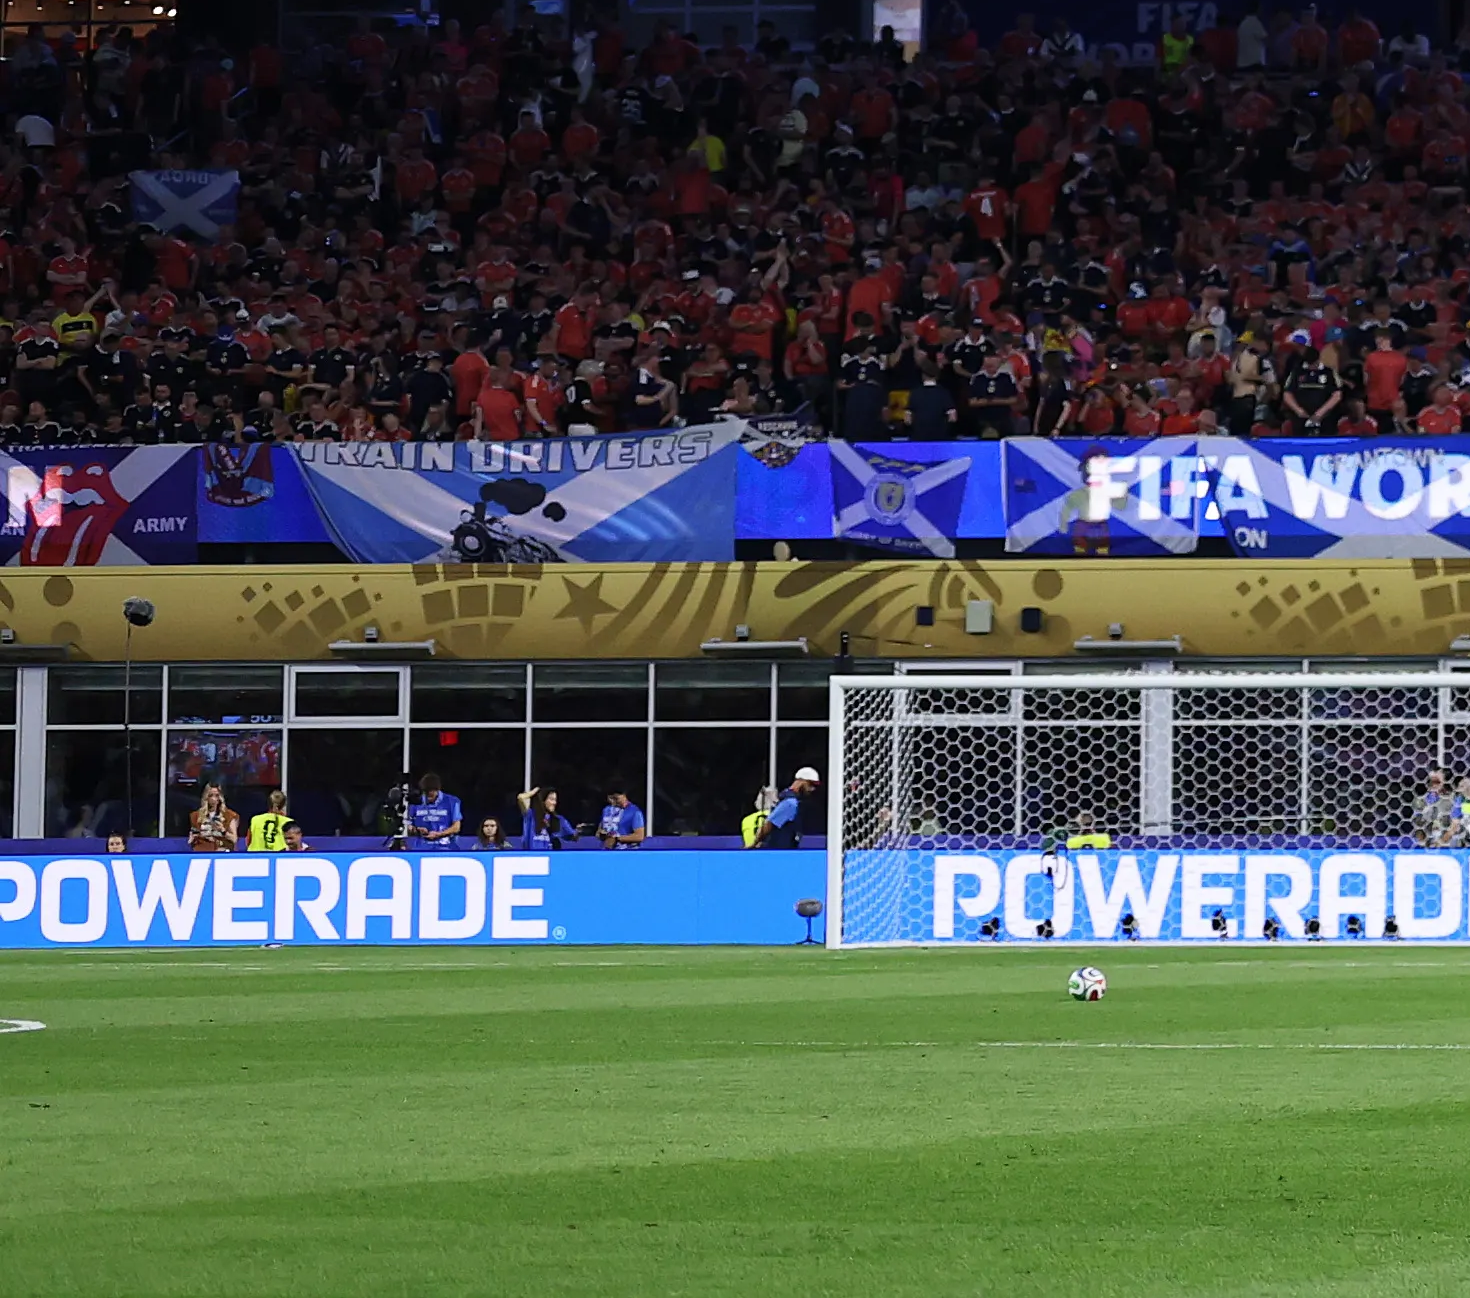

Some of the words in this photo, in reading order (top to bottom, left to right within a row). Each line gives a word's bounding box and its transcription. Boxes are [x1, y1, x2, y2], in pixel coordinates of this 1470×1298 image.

[302, 441, 454, 472] TRAIN
[471, 429, 714, 473] DRIVERS
[1089, 453, 1269, 519] FIFA
[133, 517, 187, 533] ARMY
[1235, 527, 1268, 549] ON
